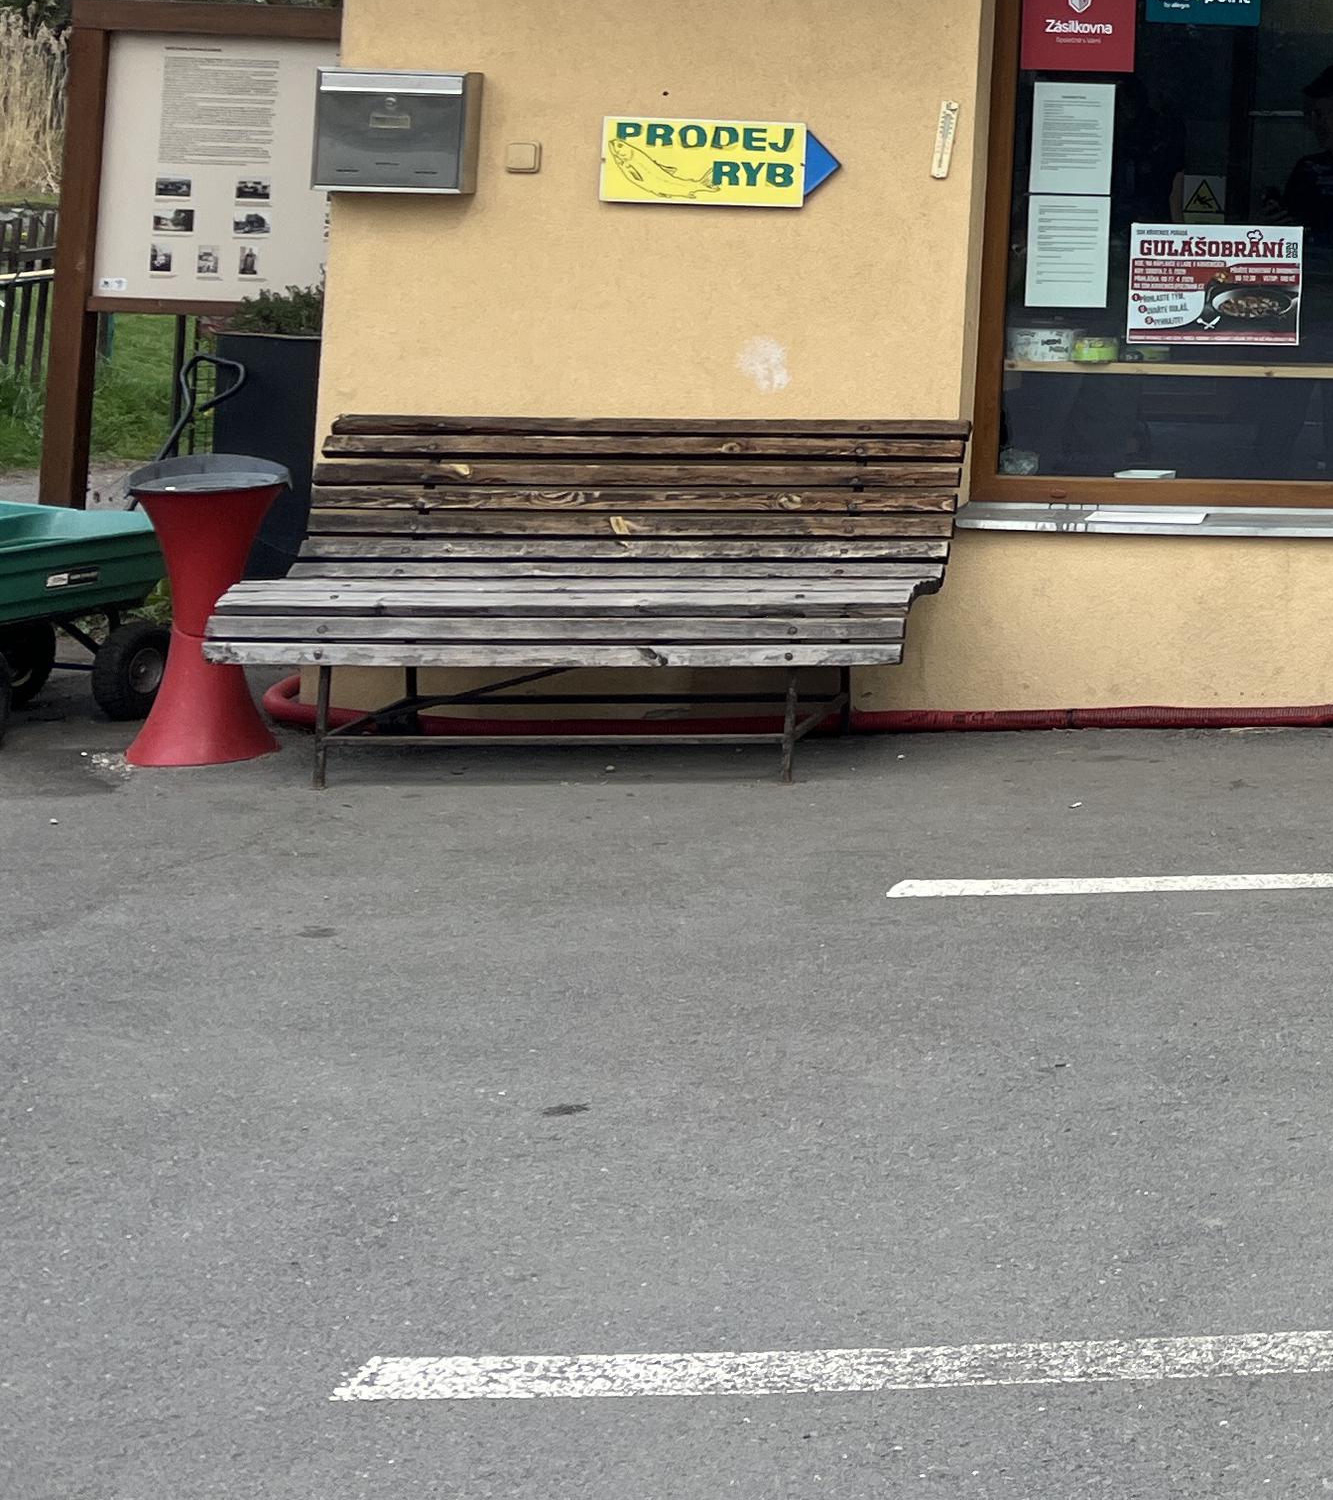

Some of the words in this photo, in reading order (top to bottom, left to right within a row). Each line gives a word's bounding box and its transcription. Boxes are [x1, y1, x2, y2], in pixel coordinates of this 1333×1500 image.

[1045, 19, 1113, 35] Zásilkovna
[616, 122, 795, 153] PRODEJ
[711, 161, 794, 188] RYB
